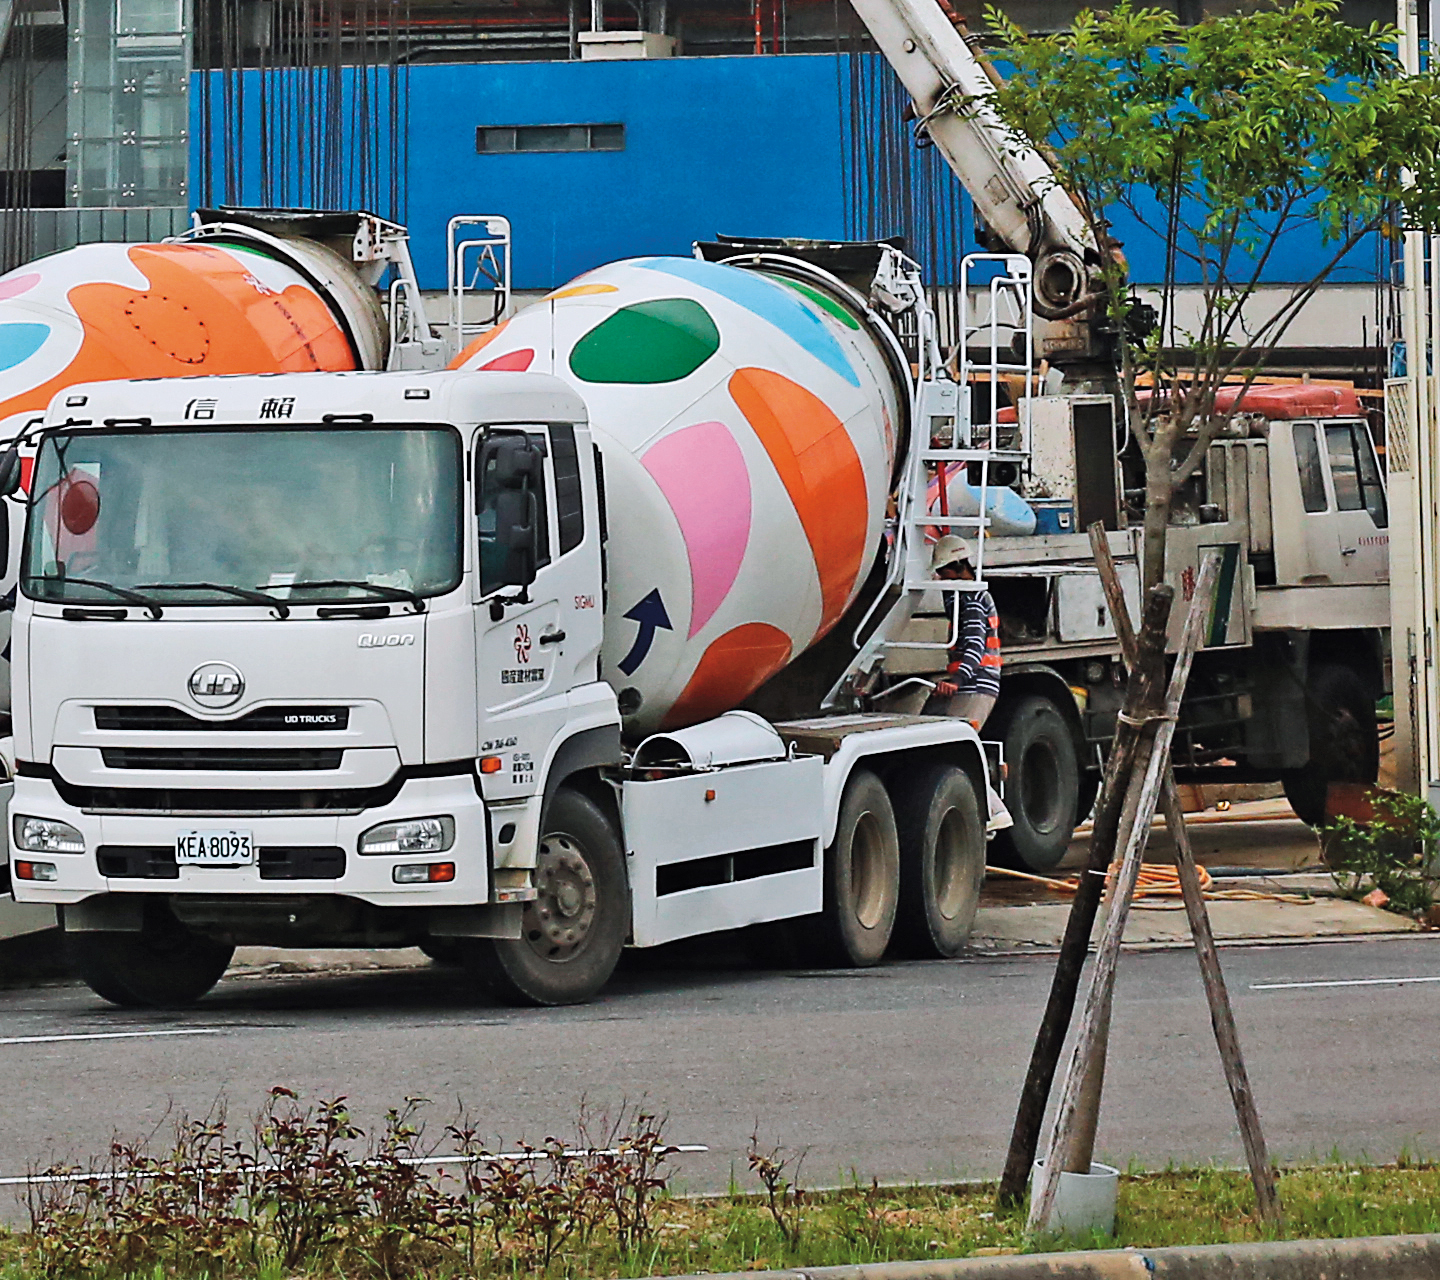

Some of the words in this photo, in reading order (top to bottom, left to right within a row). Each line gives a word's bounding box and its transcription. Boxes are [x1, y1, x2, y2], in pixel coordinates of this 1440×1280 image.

[183, 396, 296, 421] 信賴
[284, 715, 298, 723] UD
[299, 715, 337, 723] TRUCKS
